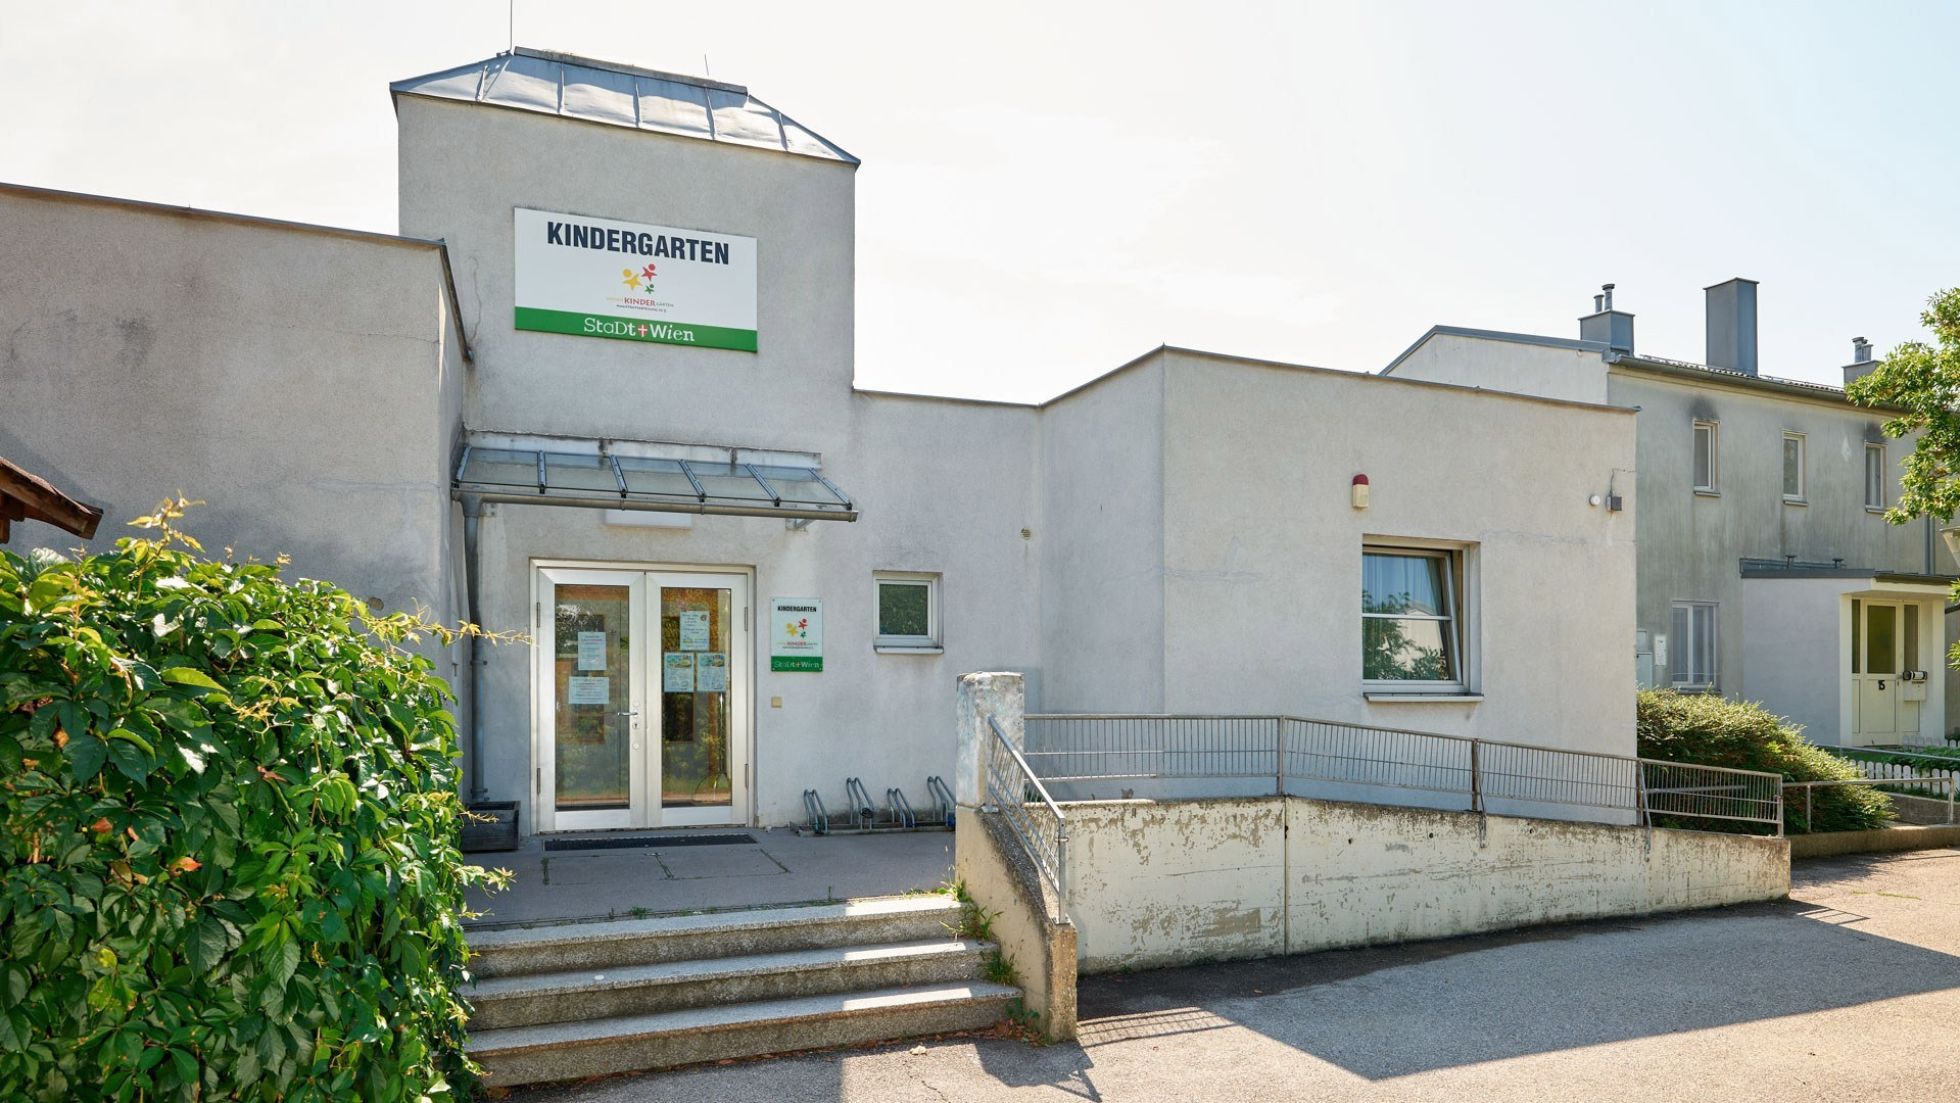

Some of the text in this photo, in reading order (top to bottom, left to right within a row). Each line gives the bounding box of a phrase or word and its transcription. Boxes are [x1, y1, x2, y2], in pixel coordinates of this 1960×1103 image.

[547, 221, 729, 265] KINDERGARTEN
[650, 323, 695, 342] Wien
[777, 605, 817, 613] KINDERGARTEN
